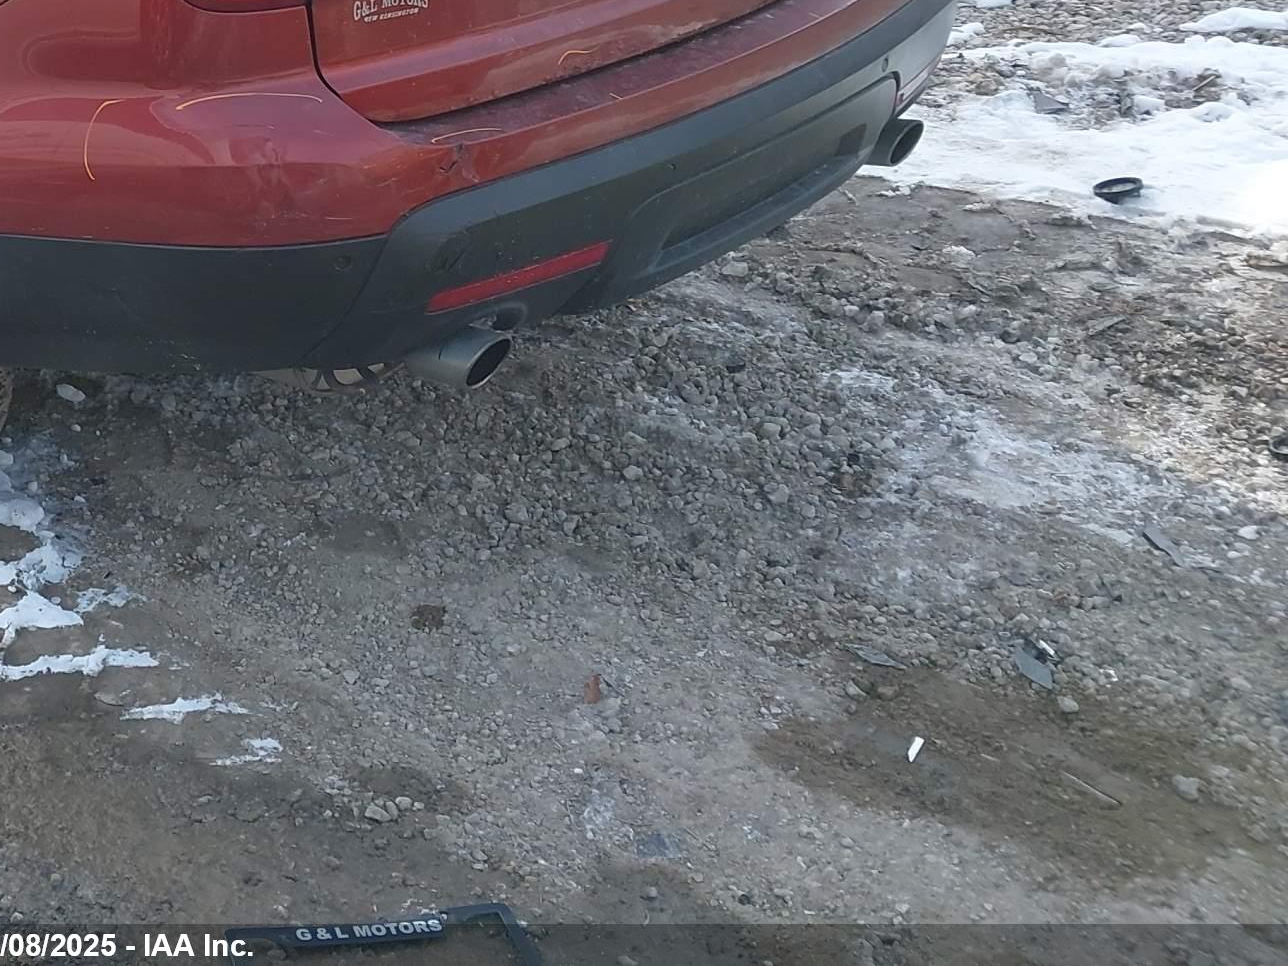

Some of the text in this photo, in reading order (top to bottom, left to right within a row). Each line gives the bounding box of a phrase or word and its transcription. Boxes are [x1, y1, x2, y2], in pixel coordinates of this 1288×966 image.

[295, 919, 443, 942] G & L MOTORS
